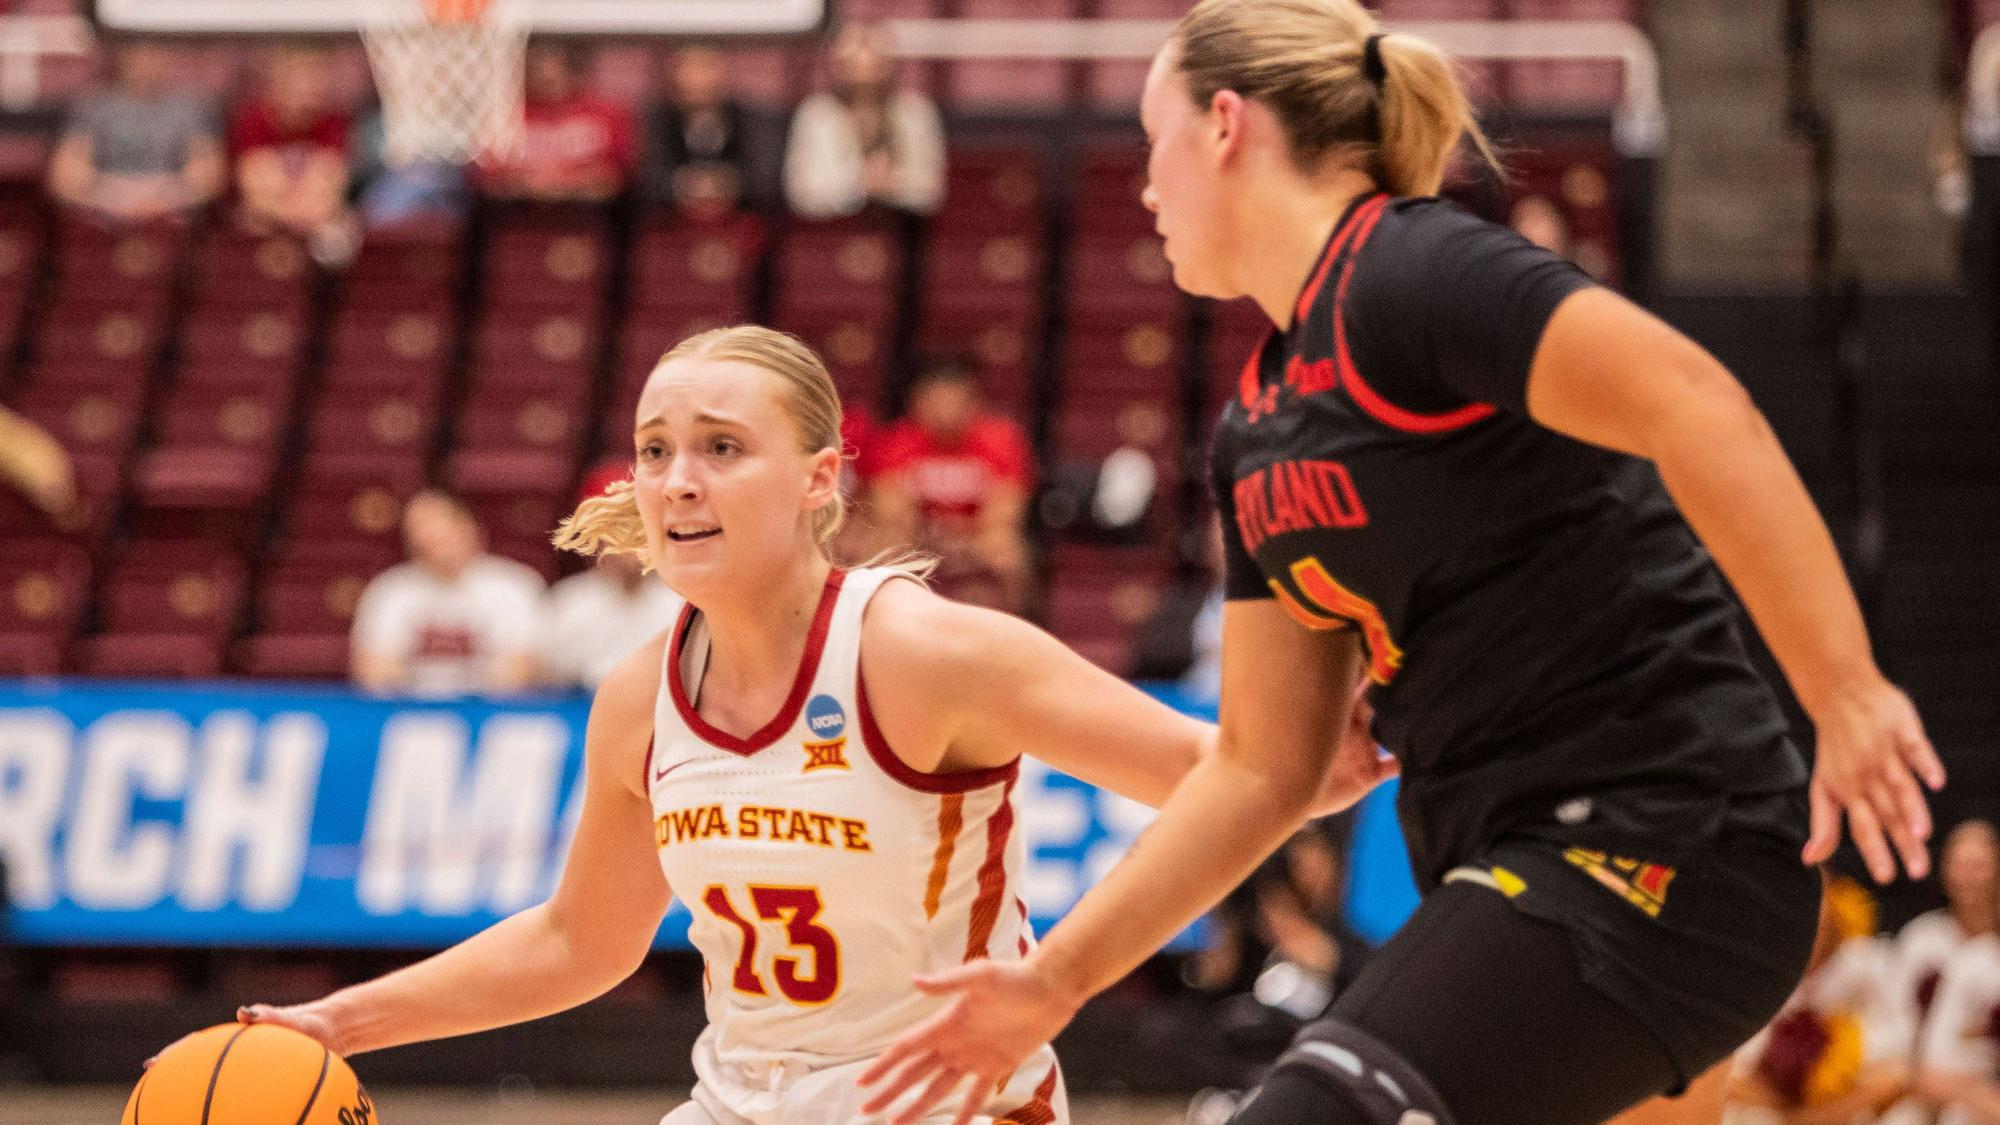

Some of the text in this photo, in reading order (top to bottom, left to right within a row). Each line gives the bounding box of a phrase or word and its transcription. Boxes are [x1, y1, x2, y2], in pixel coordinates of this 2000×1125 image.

[811, 713, 845, 731] NCAA
[656, 804, 874, 853] OWA STATE
[703, 883, 842, 1008] 13
